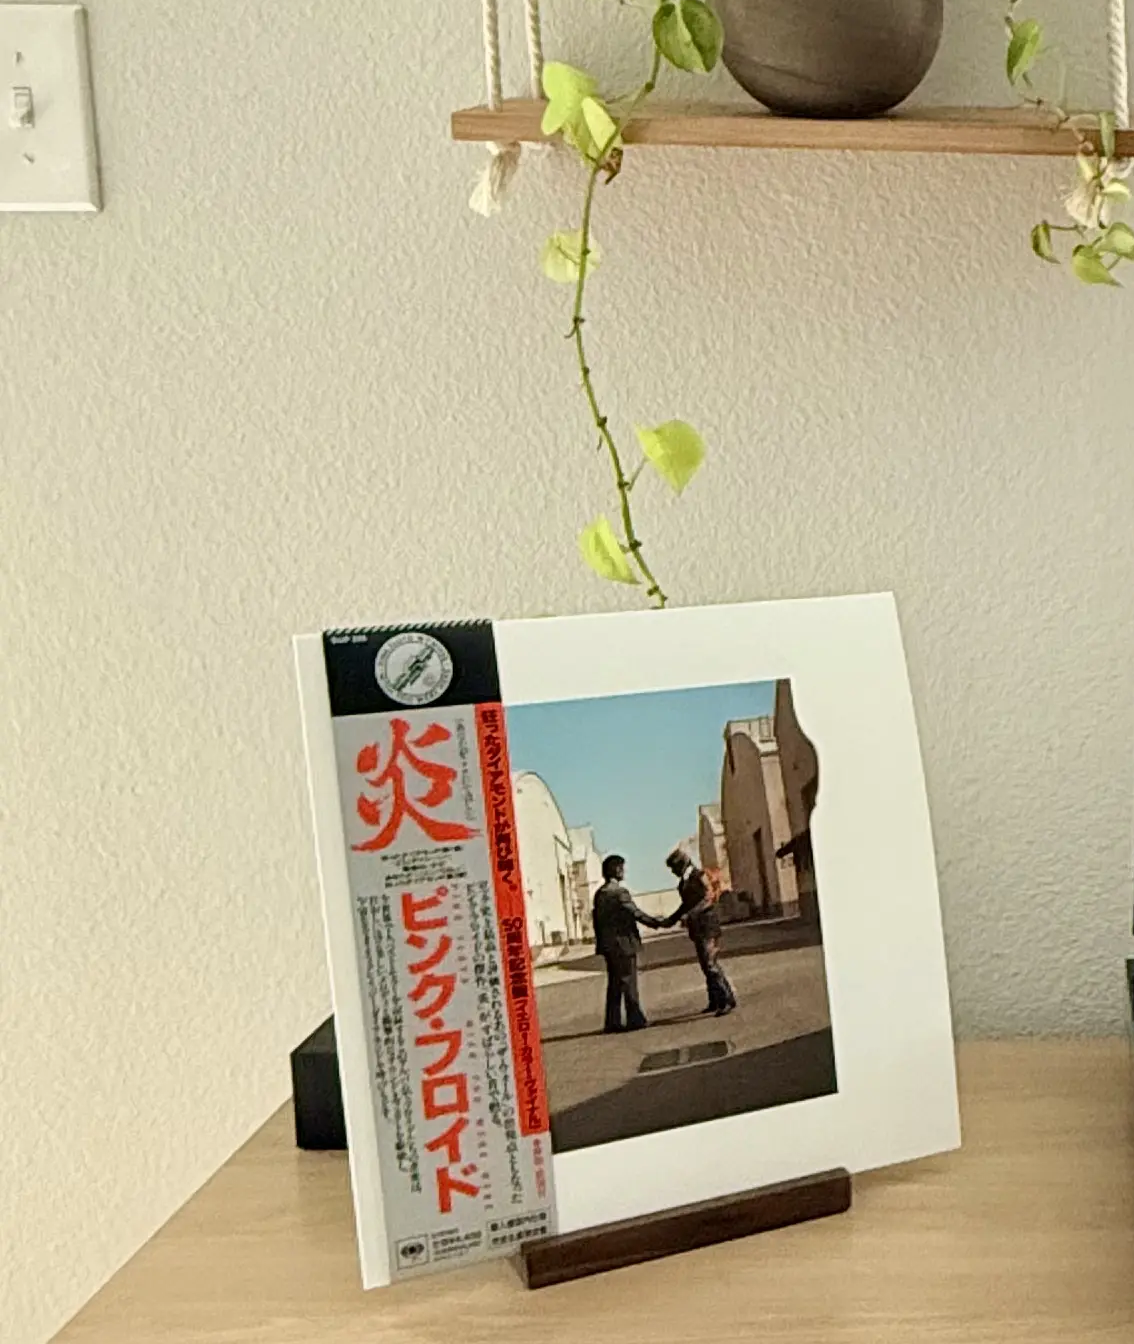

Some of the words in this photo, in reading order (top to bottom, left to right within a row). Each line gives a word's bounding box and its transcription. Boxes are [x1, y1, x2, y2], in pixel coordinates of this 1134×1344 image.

[351, 717, 484, 854] 炎
[401, 884, 480, 1214] ピンク・フロイド
